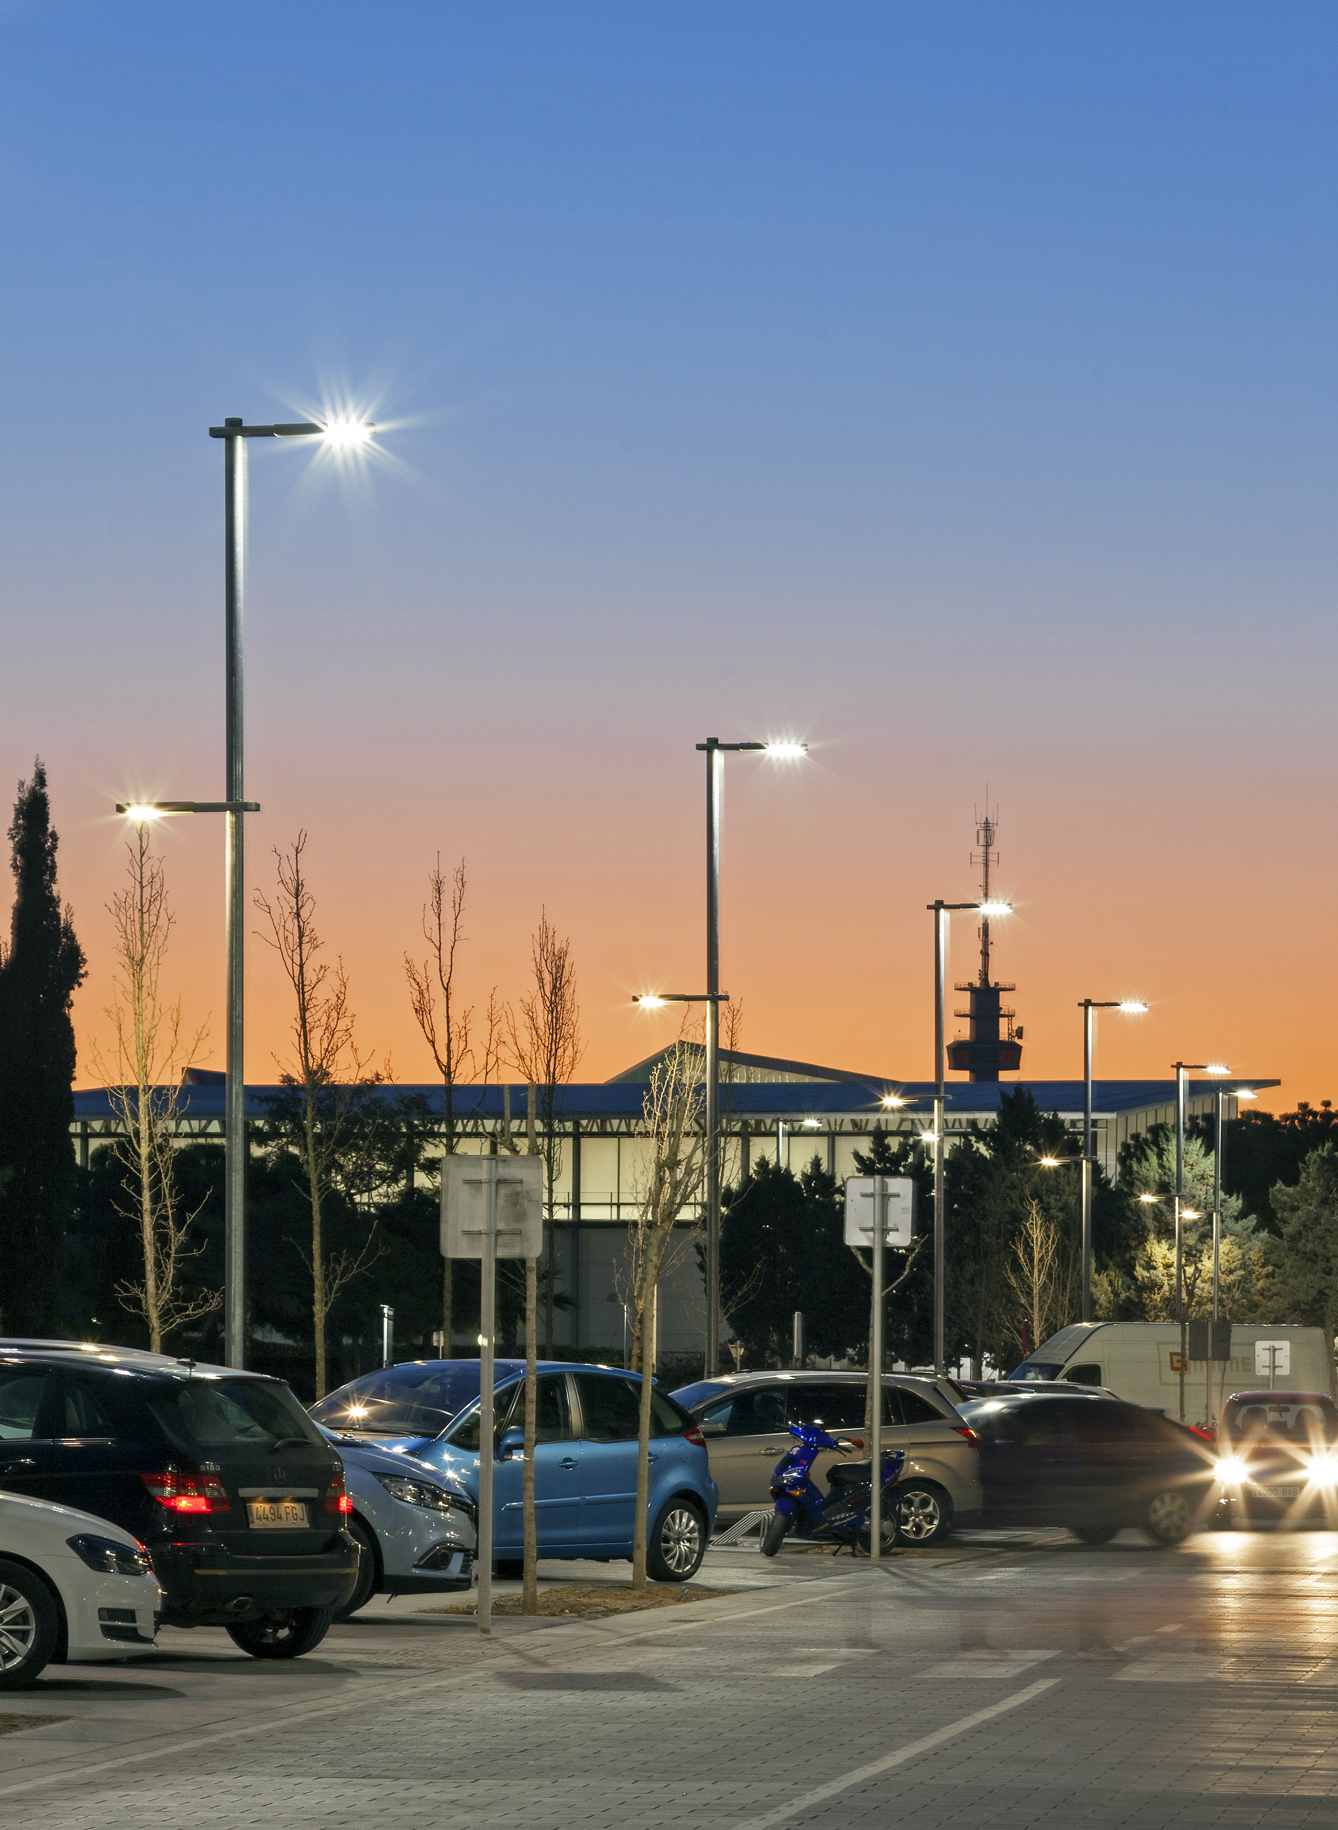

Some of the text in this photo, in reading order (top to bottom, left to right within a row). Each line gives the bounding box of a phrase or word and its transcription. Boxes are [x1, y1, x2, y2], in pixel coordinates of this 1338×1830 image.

[1282, 1488, 1298, 1496] BXB
[255, 1506, 305, 1522] 4494 FGJ
